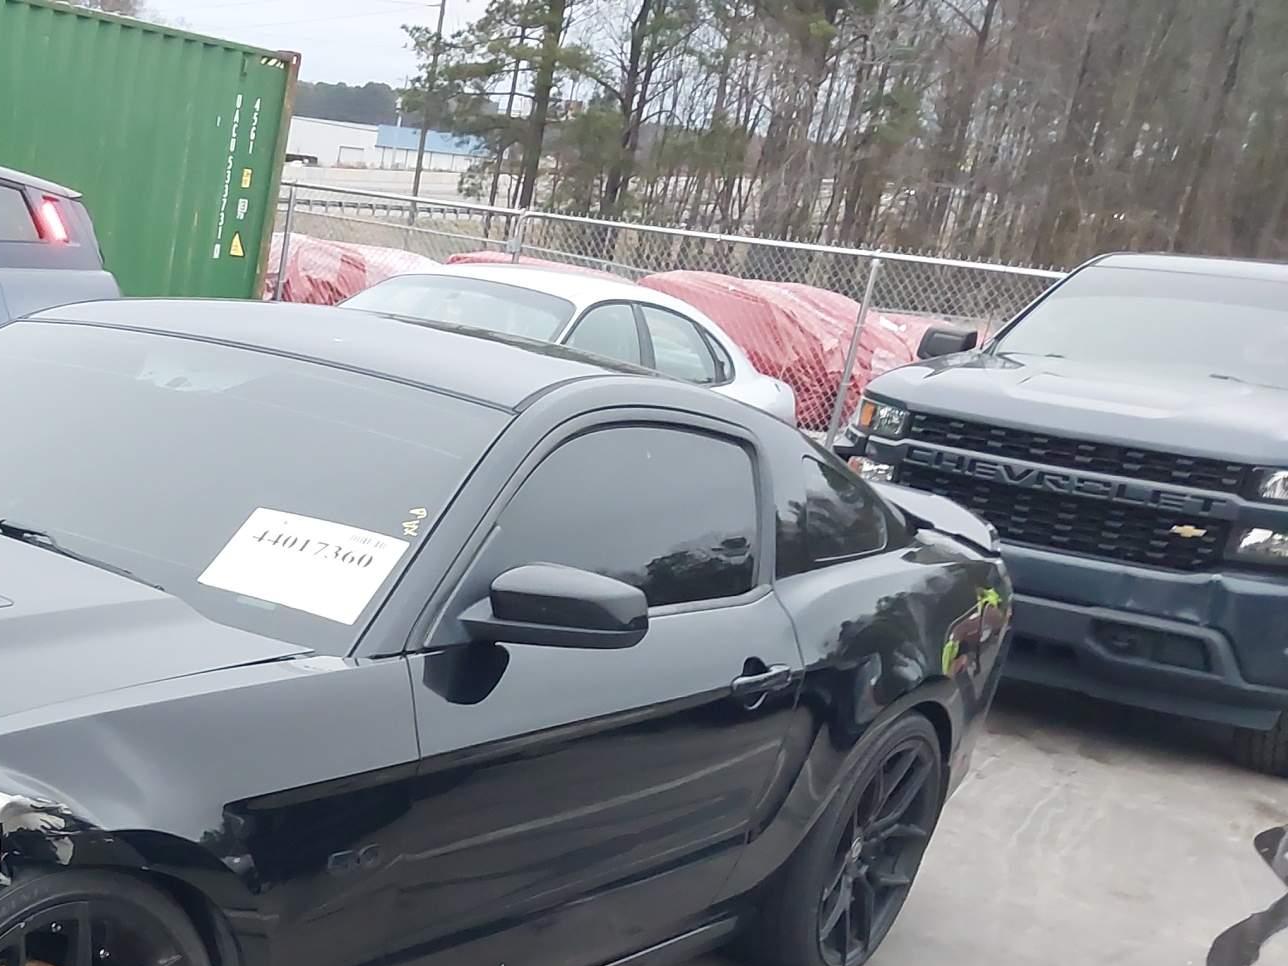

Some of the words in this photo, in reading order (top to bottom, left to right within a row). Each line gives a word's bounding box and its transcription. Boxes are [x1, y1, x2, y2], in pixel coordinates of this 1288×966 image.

[229, 94, 243, 152] UACU
[903, 447, 1231, 518] CHEVROLET
[253, 530, 374, 568] 44017360
